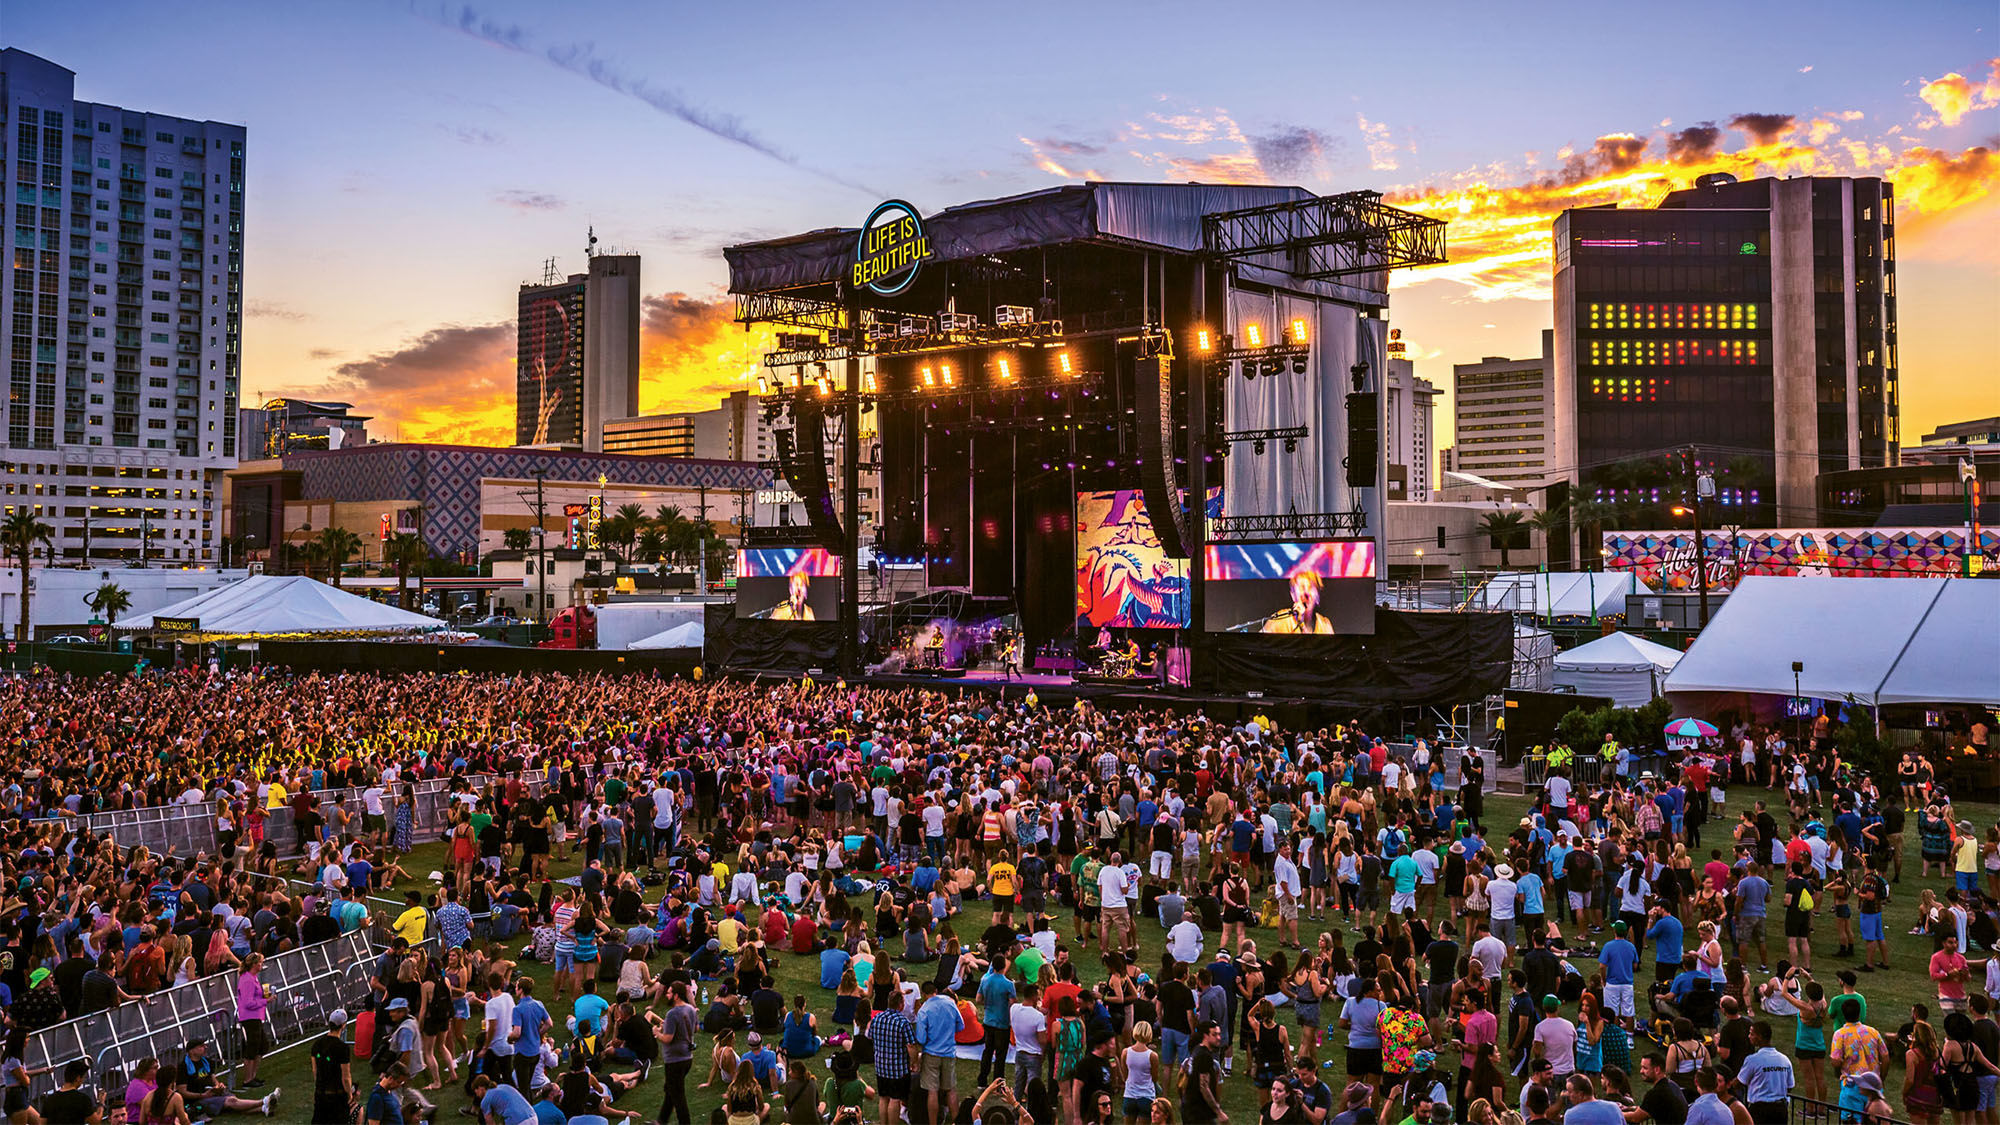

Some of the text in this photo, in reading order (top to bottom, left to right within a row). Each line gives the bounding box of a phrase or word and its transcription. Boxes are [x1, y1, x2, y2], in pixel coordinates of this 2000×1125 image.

[868, 217, 914, 254] LIFE IS
[853, 237, 931, 287] BEAUTIFUL
[569, 349, 577, 377] LAS
[89, 627, 104, 635] STOP
[159, 620, 192, 631] RESTROOMS
